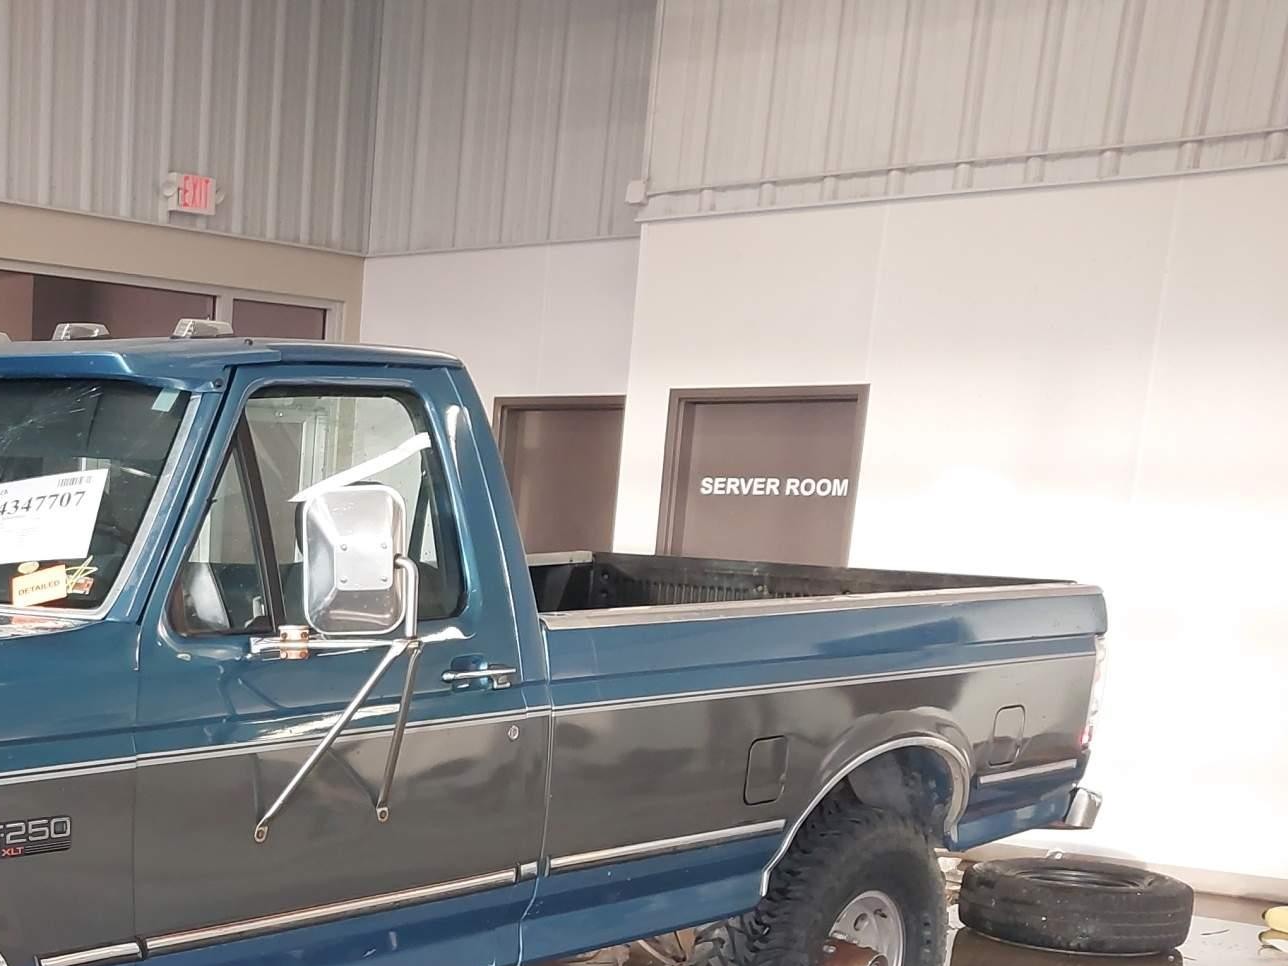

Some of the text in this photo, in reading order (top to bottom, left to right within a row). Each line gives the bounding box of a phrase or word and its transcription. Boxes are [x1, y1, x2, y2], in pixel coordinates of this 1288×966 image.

[182, 175, 210, 208] EXIT
[699, 477, 849, 497] SERVER ROOM
[18, 579, 61, 597] DETAILED
[1, 846, 25, 857] XLT
